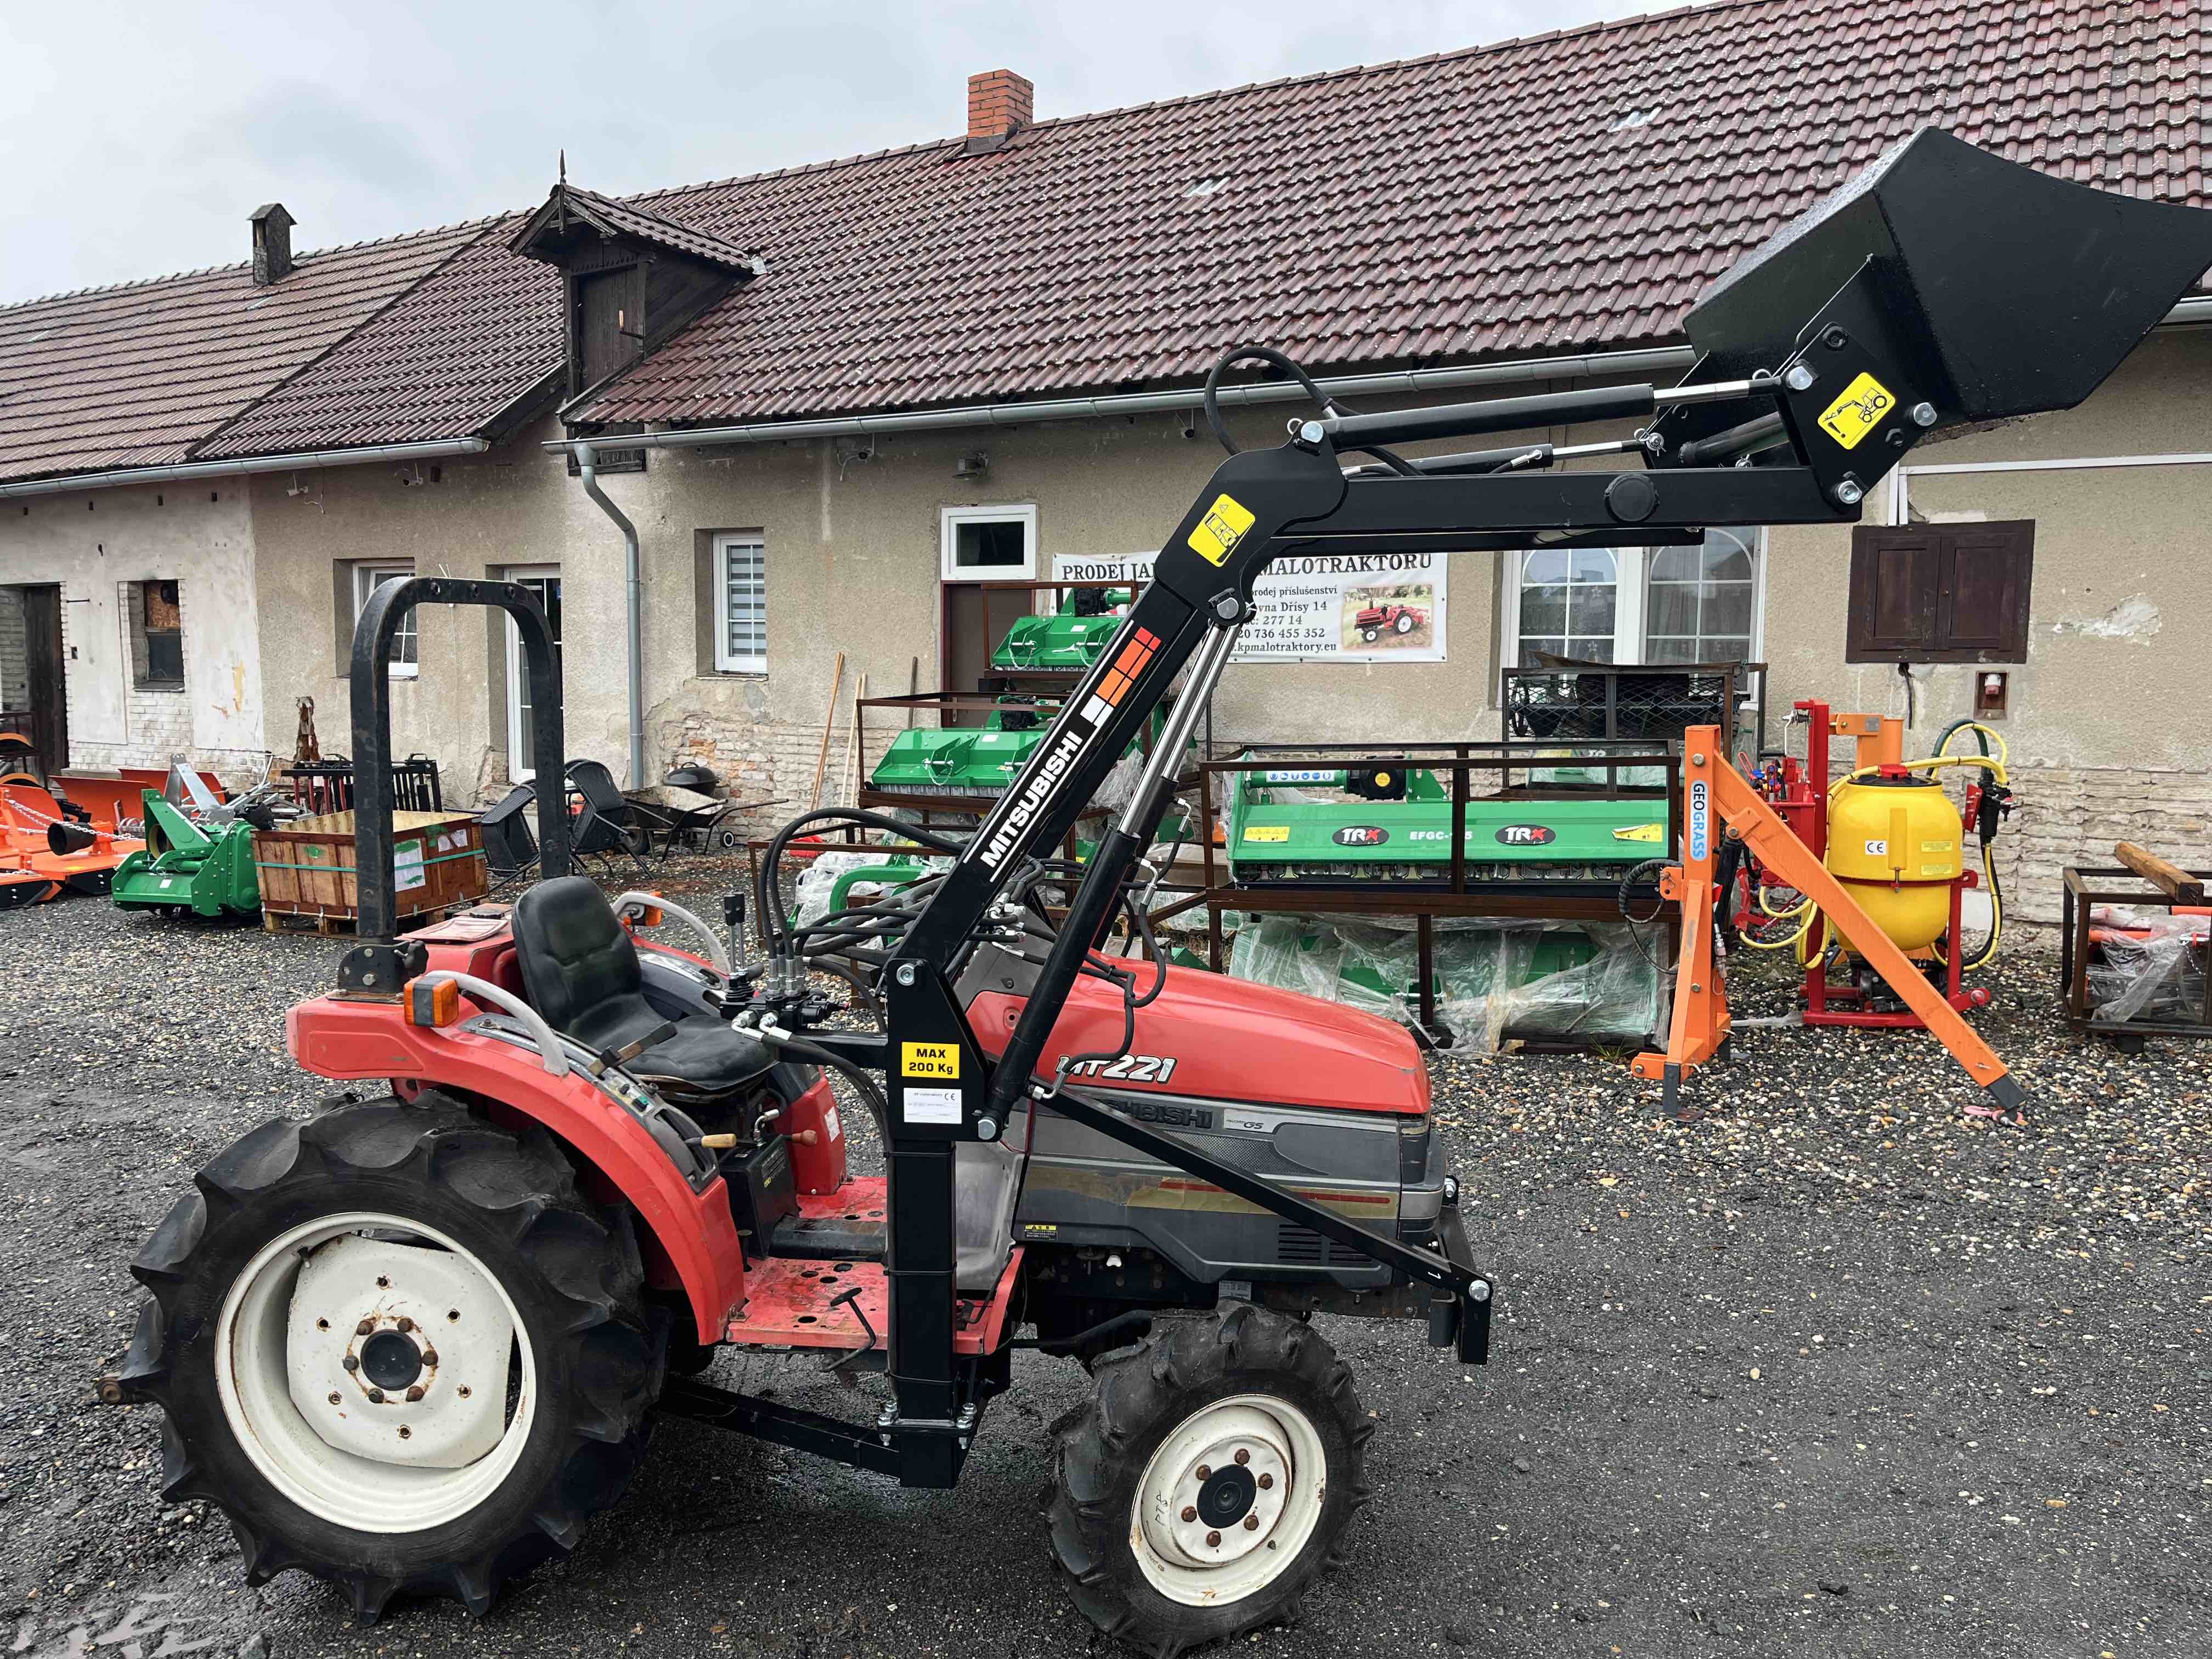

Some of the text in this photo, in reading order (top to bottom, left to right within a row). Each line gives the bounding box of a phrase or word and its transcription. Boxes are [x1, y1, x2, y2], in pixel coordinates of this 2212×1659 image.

[1062, 563, 1125, 581] PRODEJ
[1279, 585, 1338, 599] příslušenství
[1281, 601, 1309, 613] Dřísy
[1313, 601, 1327, 611] 14
[1263, 616, 1285, 625] 277
[1289, 616, 1303, 625] 14
[1238, 628, 1325, 639] 20 736 455 352
[1233, 642, 1337, 654] .kpmalotraktory.eu
[980, 730, 1084, 868] MITSUBISHI
[1694, 783, 1705, 857] GEOGRASS
[1341, 828, 1382, 842] TRX
[1409, 831, 1472, 840] EFGC-5
[1505, 827, 1547, 841] TRX
[1867, 842, 1883, 853] CE
[916, 1048, 946, 1058] MAX
[909, 1062, 953, 1075] 200 Kg
[944, 1093, 956, 1101] CE
[1243, 1121, 1264, 1130] GS
